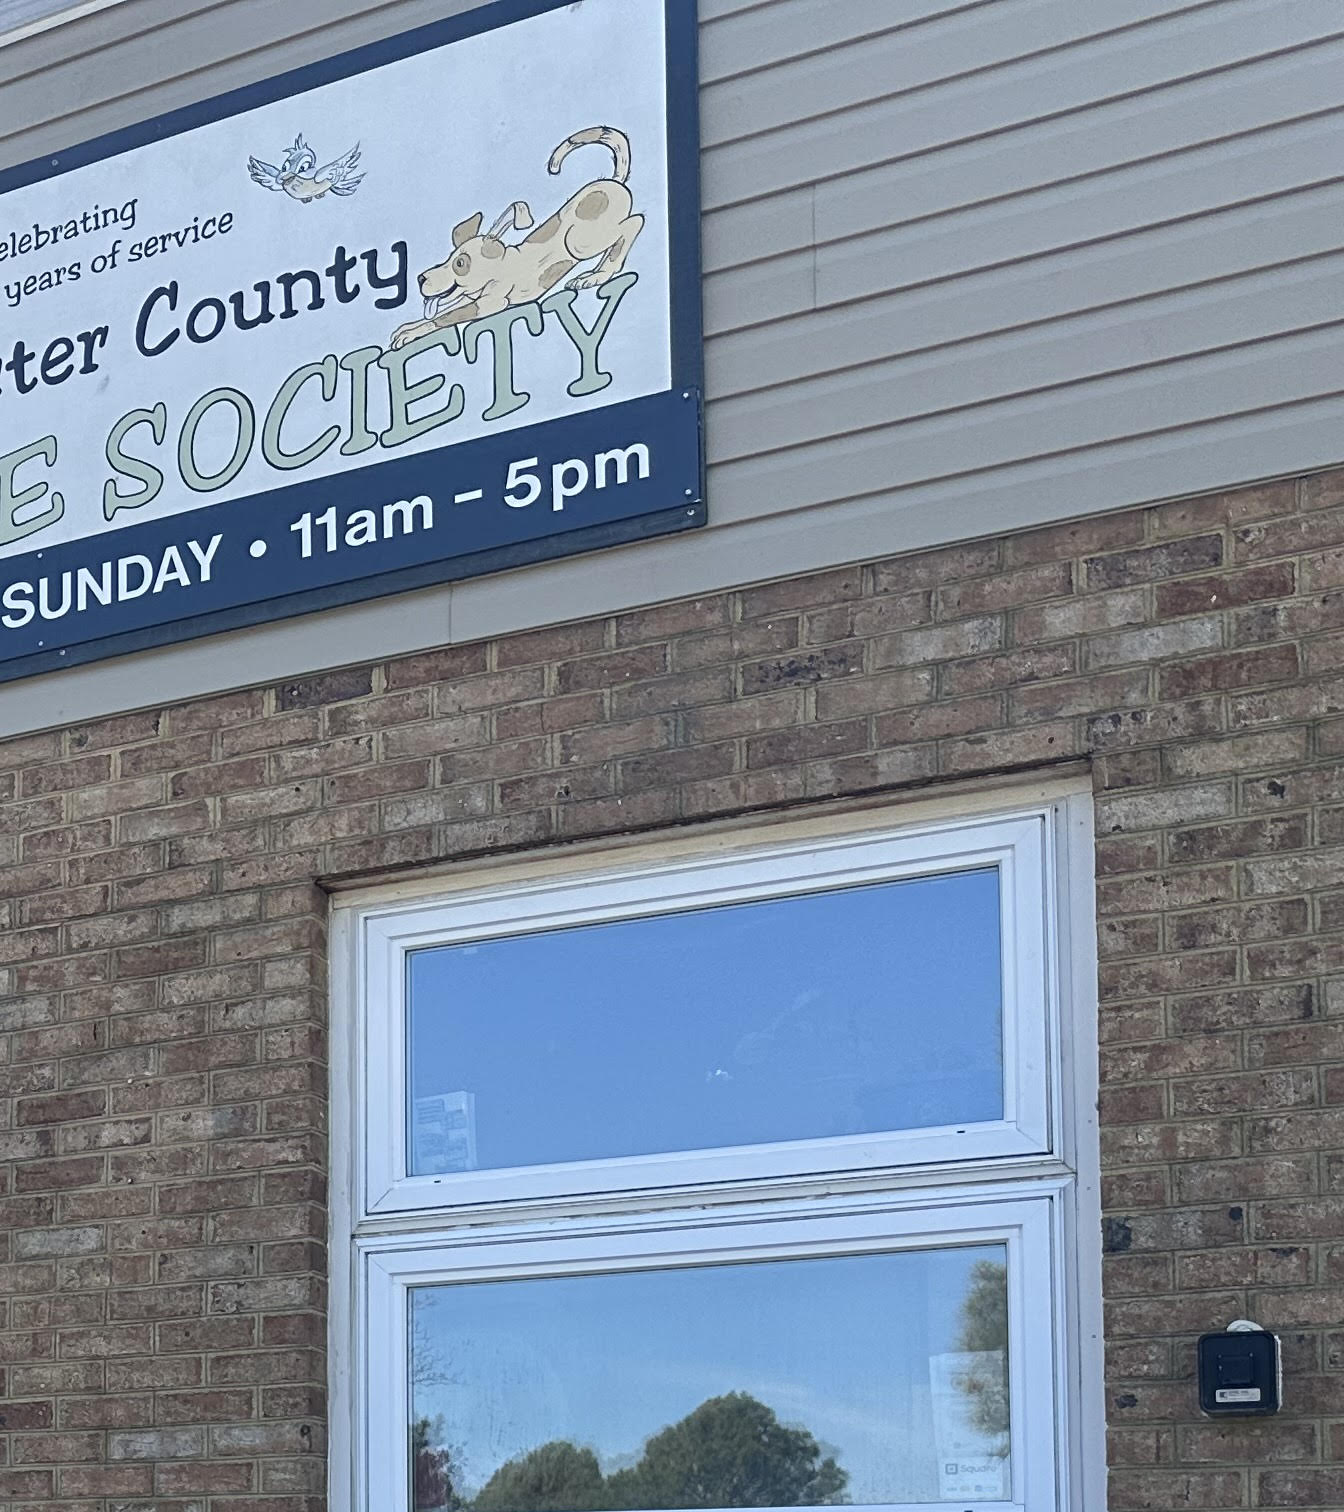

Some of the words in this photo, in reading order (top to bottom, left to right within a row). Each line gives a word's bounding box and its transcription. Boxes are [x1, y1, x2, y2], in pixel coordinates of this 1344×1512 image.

[3, 259, 81, 307] years
[90, 243, 121, 274] of
[127, 213, 234, 262] service
[135, 240, 409, 357] County
[102, 272, 639, 521] SOCIETY
[1, 533, 225, 629] SUNDAY
[289, 495, 434, 560] 11am
[503, 442, 651, 513] 5pm
